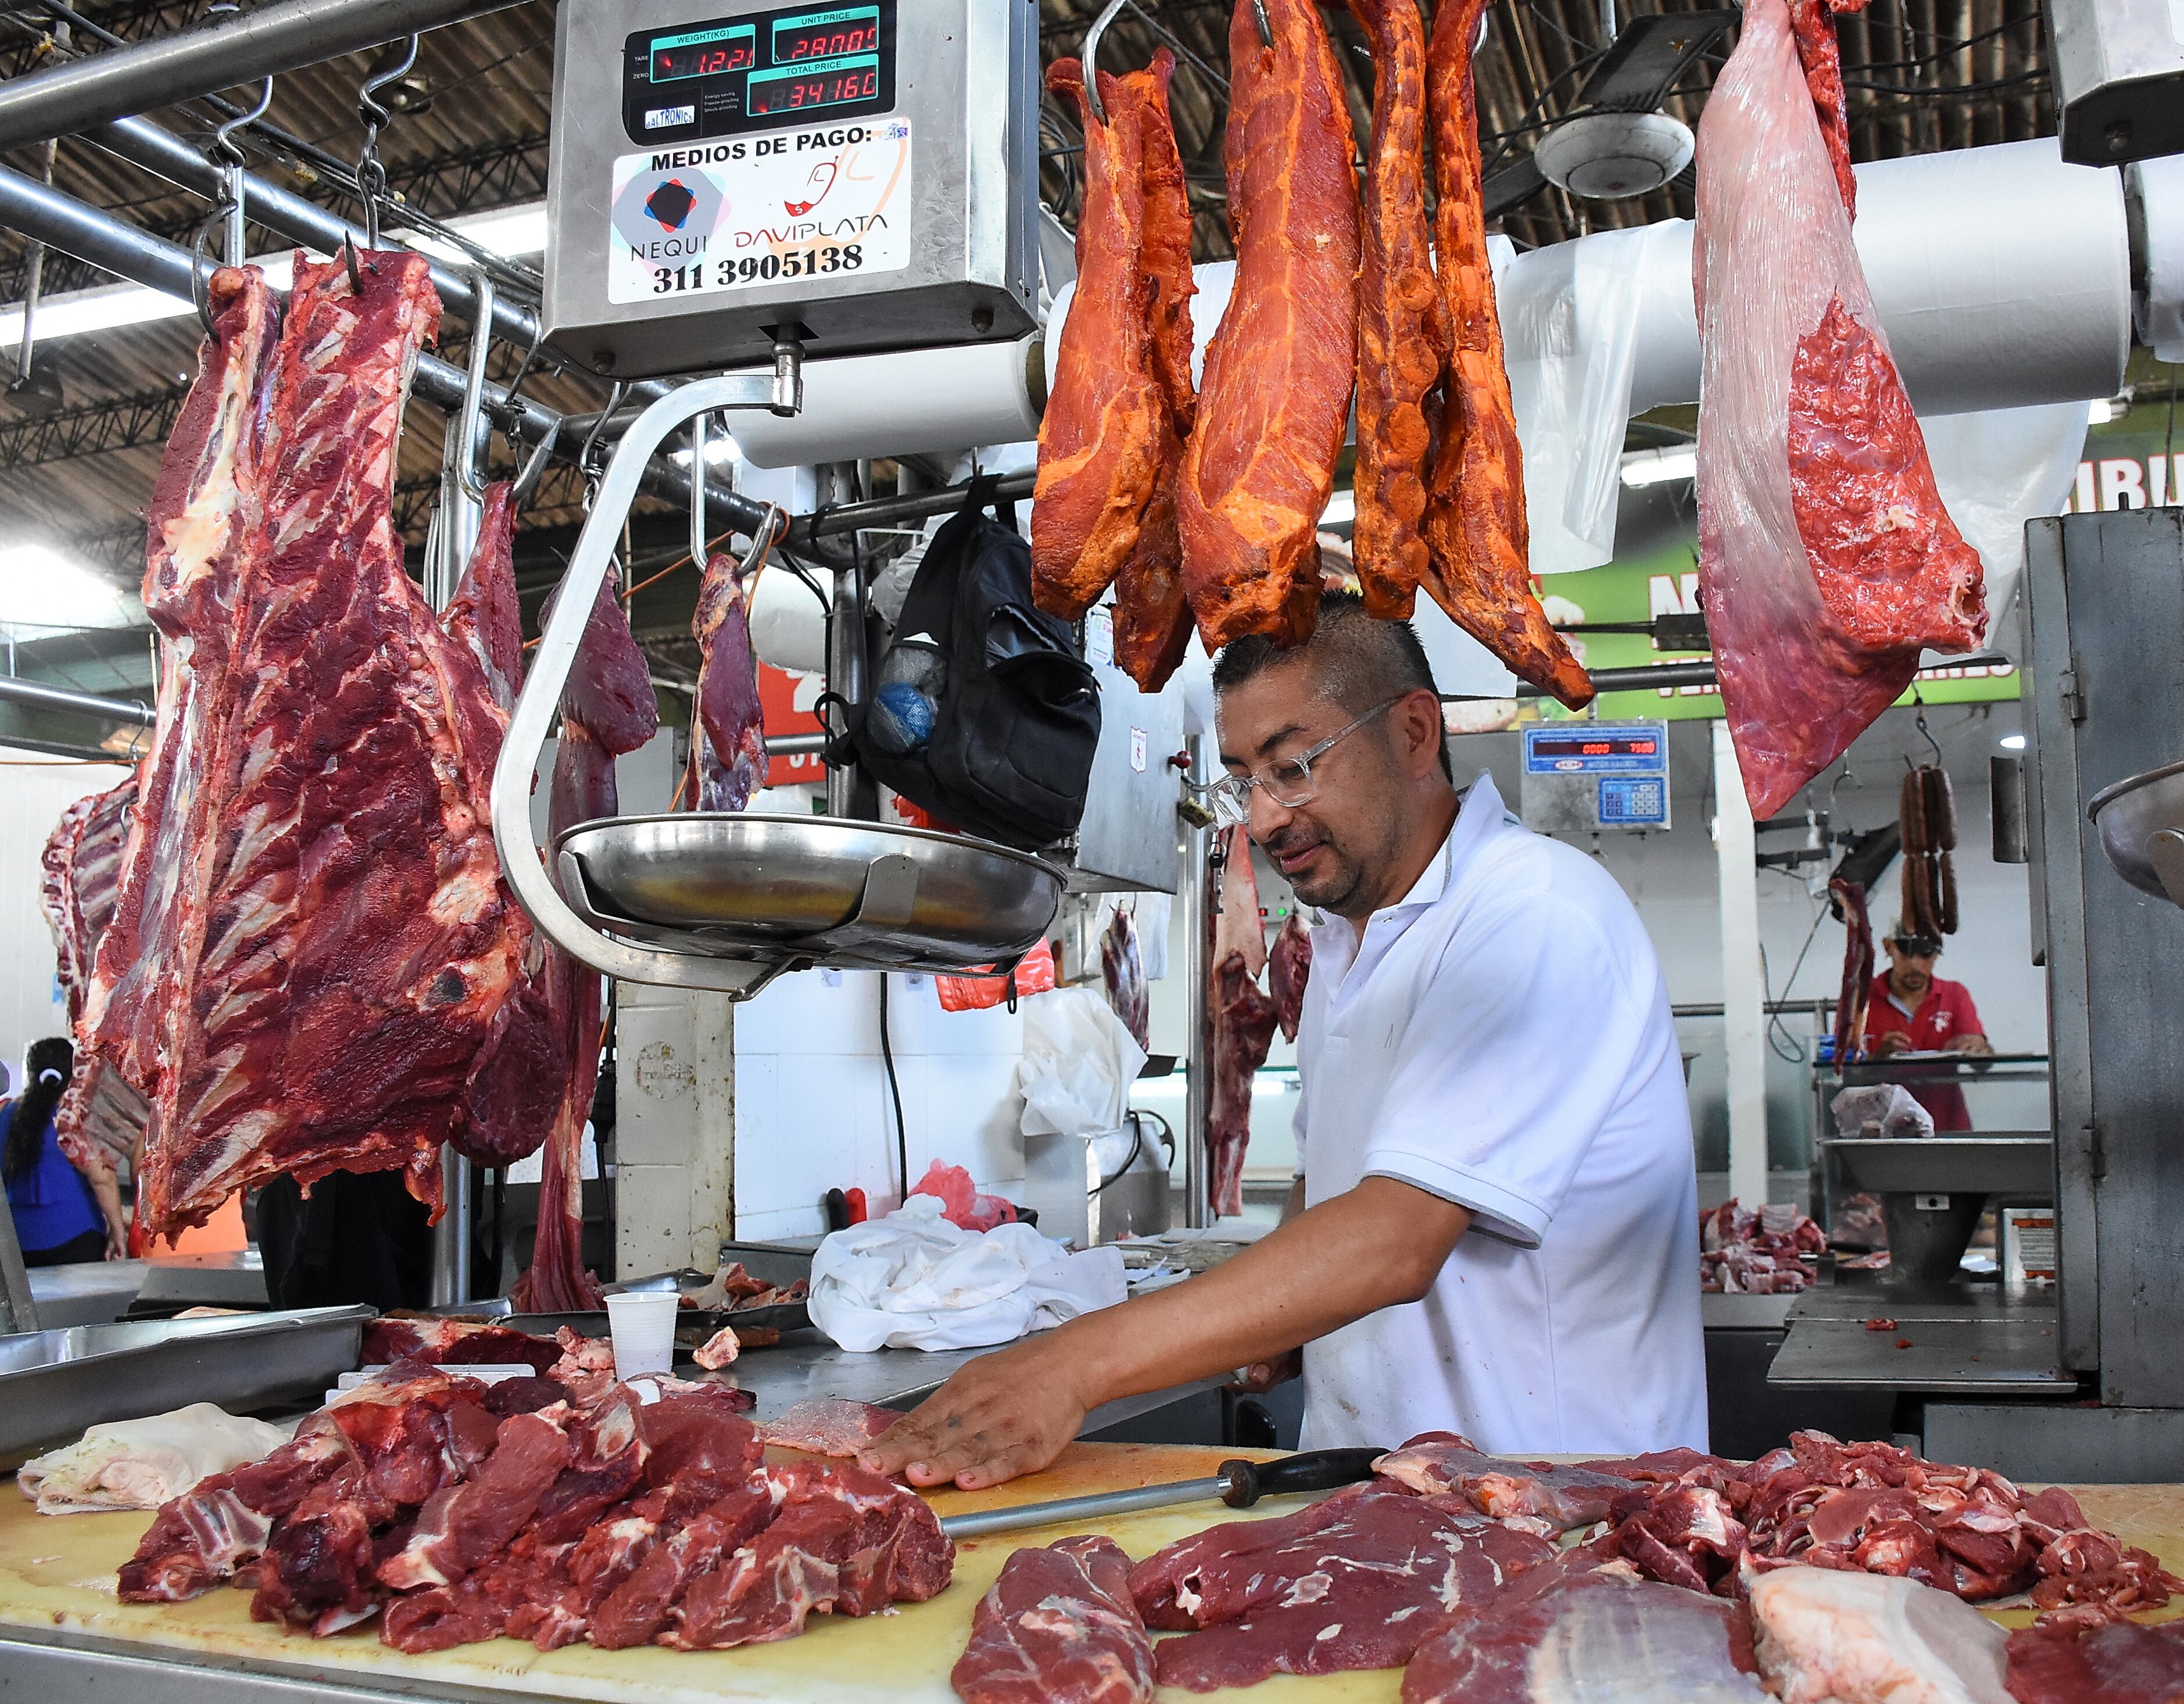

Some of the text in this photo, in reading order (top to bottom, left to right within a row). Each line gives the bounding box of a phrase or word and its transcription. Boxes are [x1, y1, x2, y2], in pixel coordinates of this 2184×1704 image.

[801, 12, 851, 25] UNIT PRICE
[677, 30, 729, 44] WEIGHT(KG)
[786, 61, 842, 76] TOTAL PRICE
[651, 127, 871, 171] MEDIOS DE PAGO:
[734, 214, 888, 248] DAVIPLATA
[631, 235, 707, 262] NEQUI
[653, 244, 862, 293] 311 3905138
